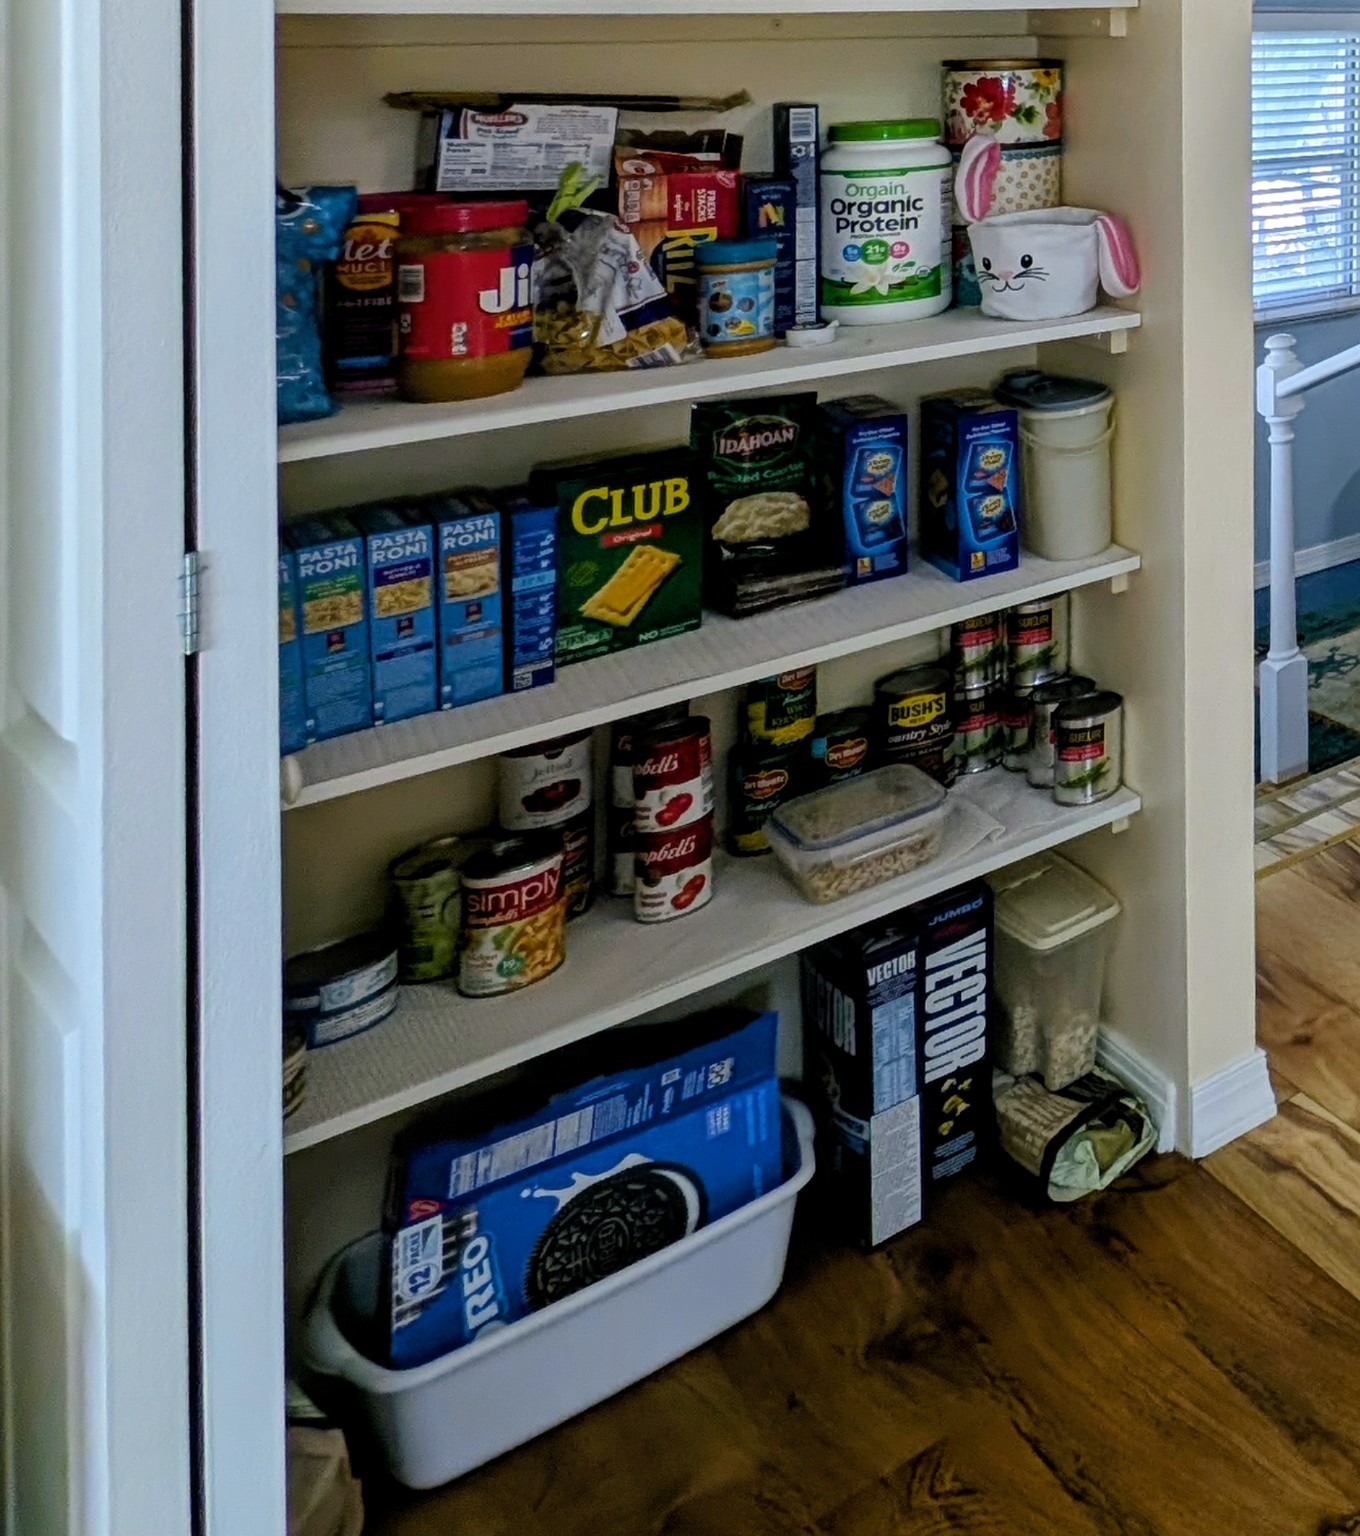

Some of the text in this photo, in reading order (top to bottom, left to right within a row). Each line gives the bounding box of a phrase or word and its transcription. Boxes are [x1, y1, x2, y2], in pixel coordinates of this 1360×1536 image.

[697, 189, 707, 222] STACKS
[707, 190, 716, 219] FRESH
[831, 195, 923, 218] Organic
[836, 214, 918, 234] Protein
[718, 427, 796, 455] IDAHOAN
[571, 477, 690, 535] CLUB
[371, 530, 427, 550] PASTA
[442, 517, 495, 538] PASTA
[442, 528, 496, 550] RONI
[612, 528, 652, 543] Original
[300, 543, 357, 564] PASTA
[300, 554, 358, 577] RONI
[371, 541, 428, 565] RONI
[891, 697, 943, 722] BUSH'S
[467, 870, 561, 912] simply
[928, 897, 984, 927] JUMBO
[867, 949, 916, 987] VECTOR
[925, 927, 986, 1084] VECTOR
[409, 1266, 431, 1294] 12
[463, 1236, 499, 1329] REO
